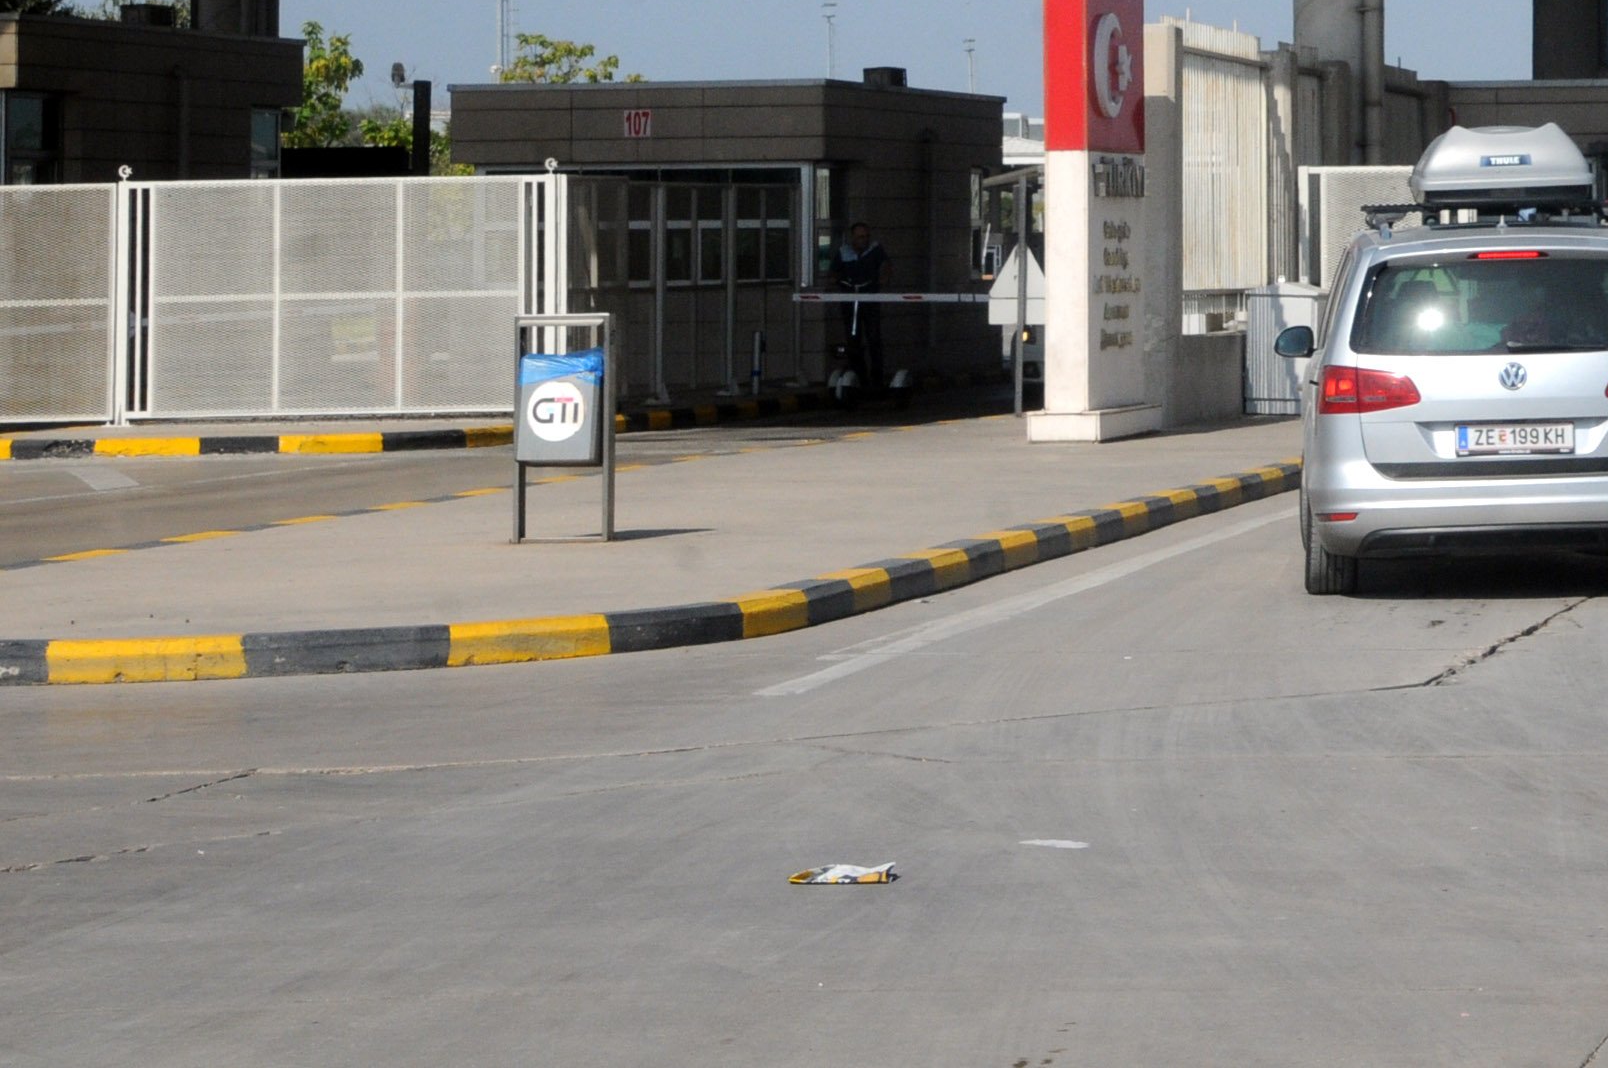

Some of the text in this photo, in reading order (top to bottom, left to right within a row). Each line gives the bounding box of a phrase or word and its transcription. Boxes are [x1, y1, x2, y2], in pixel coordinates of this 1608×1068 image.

[626, 112, 650, 136] 107
[1489, 156, 1520, 165] THULE
[1475, 430, 1495, 446] ZE
